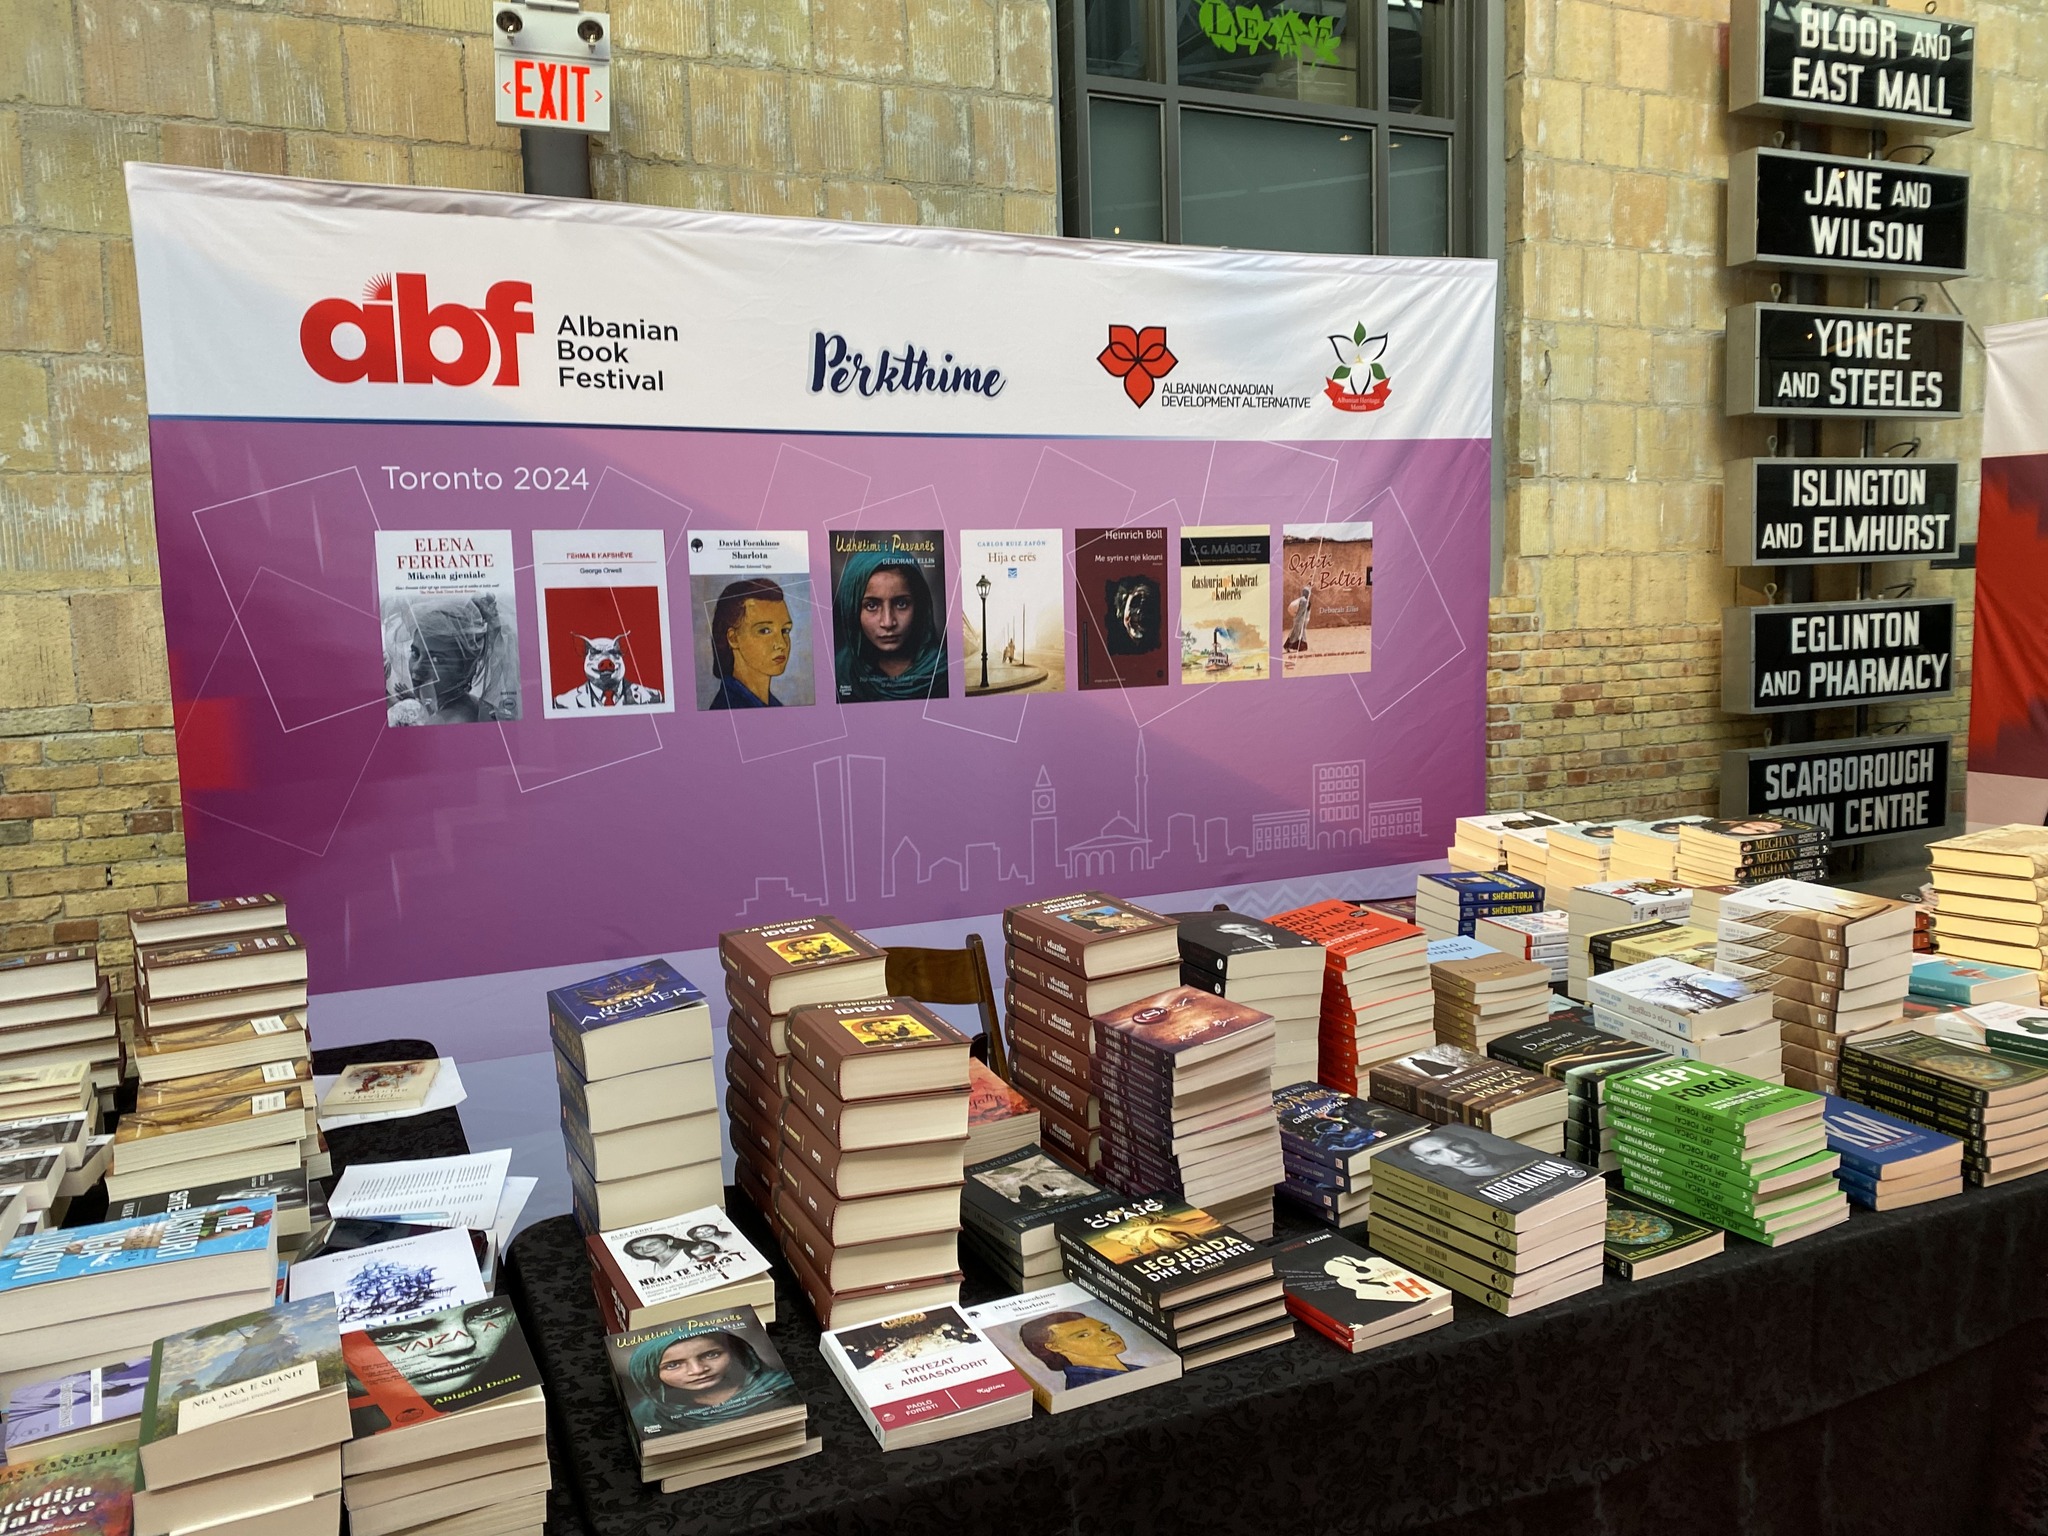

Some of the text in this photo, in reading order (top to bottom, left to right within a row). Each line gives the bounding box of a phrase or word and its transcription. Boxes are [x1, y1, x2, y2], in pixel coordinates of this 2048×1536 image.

[1209, 2, 1331, 48] LEAF
[1800, 7, 1950, 61] BLOOR AND
[514, 60, 590, 123] EXIT
[1792, 57, 1952, 115] EAST MALL
[1804, 167, 1932, 210] JANE AND
[1810, 215, 1924, 262] WILSON
[300, 271, 535, 387] abf
[557, 314, 679, 342] Albanian
[1814, 318, 1912, 361] YONGE
[558, 340, 629, 364] Book
[558, 367, 665, 392] Festival
[1162, 382, 1273, 396] ALBANIAN CANADIAN
[1778, 367, 1942, 408] AND STEELES
[1161, 395, 1311, 408] DEVELOPMENT ALTERNATIVE
[381, 465, 590, 491] Toronto 2024
[1793, 469, 1926, 507] ISLINGTON
[719, 539, 780, 547] David Foenkinos
[835, 534, 935, 553] Udhëtimi Parvanës
[1105, 530, 1162, 540] Heinrich Böll
[1761, 514, 1949, 554] AND ELMHURST
[415, 538, 474, 552] ELENA
[732, 550, 768, 560] Sharlota
[397, 554, 494, 570] FERRANTE
[882, 557, 915, 565] DEBORAH
[988, 552, 1008, 565] Hija
[1019, 553, 1036, 562] erës
[1095, 554, 1105, 562] Me
[1107, 554, 1123, 564] syrin
[1142, 553, 1163, 561] klouni
[407, 570, 486, 581] Mikesha gjeniale
[579, 567, 602, 575] George
[1320, 570, 1364, 590] Baltës
[1791, 611, 1920, 654] EGLINTON
[1760, 652, 1949, 699] AND PHARMACY
[1765, 748, 1934, 801] SCARBOROUGH
[1769, 790, 1930, 837] WN CENTRE
[1755, 832, 1818, 850] MEGHAN ANDREW
[1756, 844, 1820, 864] MEGHAN ANDREW
[1750, 862, 1791, 877] MEGHAN
[1492, 891, 1535, 901] SHËRBËTORJA
[1271, 911, 1307, 927] ARTI
[1491, 905, 1533, 915] SHËRBËTORJA
[760, 923, 815, 938] IDIOTI
[1301, 919, 1357, 938] GIVING
[834, 1004, 893, 1015] IDIOTI
[1449, 1067, 1521, 1096] VARREZA
[1475, 1074, 1536, 1100] PRAGËS
[1612, 1082, 1630, 1092] WYNER
[1667, 1075, 1752, 1101] FORCA!
[1610, 1094, 1628, 1104] WYNER
[1631, 1089, 1652, 1099] JAYSON
[1629, 1102, 1651, 1112] JAYSON
[1479, 1160, 1573, 1203] ADRENALINA
[216, 1212, 254, 1233] ME
[1090, 1202, 1163, 1229] CVAJG
[156, 1208, 208, 1258] DASHURI
[1306, 1233, 1332, 1245] KADARE
[79, 1231, 126, 1260] NGA
[1134, 1235, 1242, 1275] LEGJENDA
[1147, 1266, 1182, 1283] DHE
[1182, 1242, 1255, 1272] PORTRETE
[1393, 1277, 1434, 1299] H
[1012, 1299, 1050, 1314] Sharlota
[396, 1330, 469, 1353] VAJZA
[884, 1358, 989, 1391] E AMBASADORIT
[901, 1356, 955, 1377] TRYEZAT
[221, 1388, 246, 1399] ANA
[433, 1373, 522, 1406] Abigail Dean
[905, 1402, 939, 1417] FORESTI
[906, 1398, 933, 1411] PAOLO
